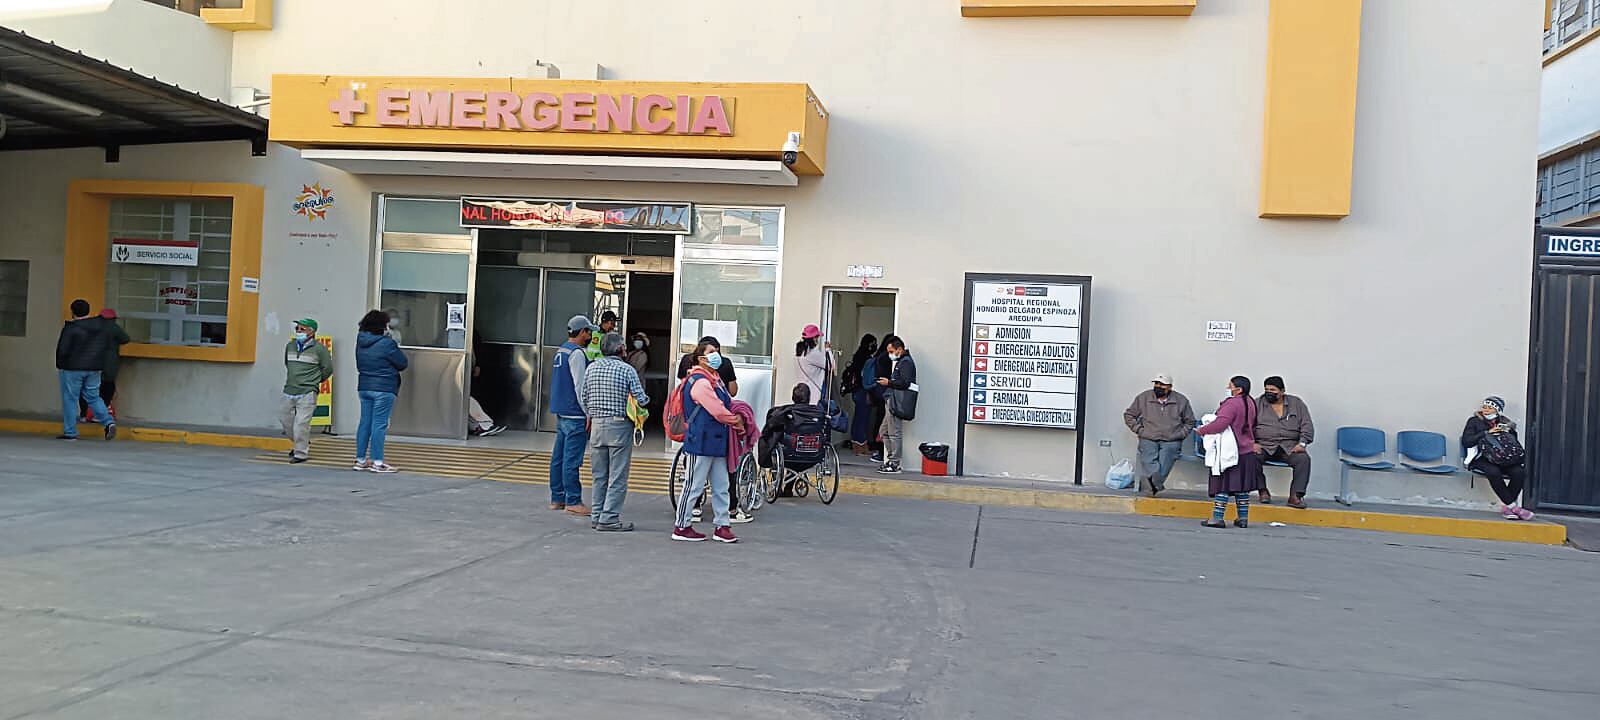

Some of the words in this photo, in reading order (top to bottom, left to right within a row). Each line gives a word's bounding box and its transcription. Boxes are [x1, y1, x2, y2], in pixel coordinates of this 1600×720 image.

[377, 88, 731, 135] EMERGENCIA
[1551, 238, 1600, 252] INGRE
[169, 252, 193, 260] SOCIAL
[991, 298, 1025, 306] HOSPITAL
[1026, 299, 1061, 307] REGIONAL
[976, 305, 1007, 313] HONORIO
[1008, 306, 1041, 314] DELGADO
[995, 327, 1031, 340] ADMISION
[994, 343, 1041, 356] EMERGENCIA
[1042, 345, 1075, 358] ADULTOS
[994, 359, 1035, 372] EMERGENCIA
[1036, 361, 1074, 375] PEDIATRICA
[990, 376, 1032, 388] SERVICIO
[992, 392, 1029, 405] FARMACIA
[992, 408, 1026, 421] EMERGENCIA
